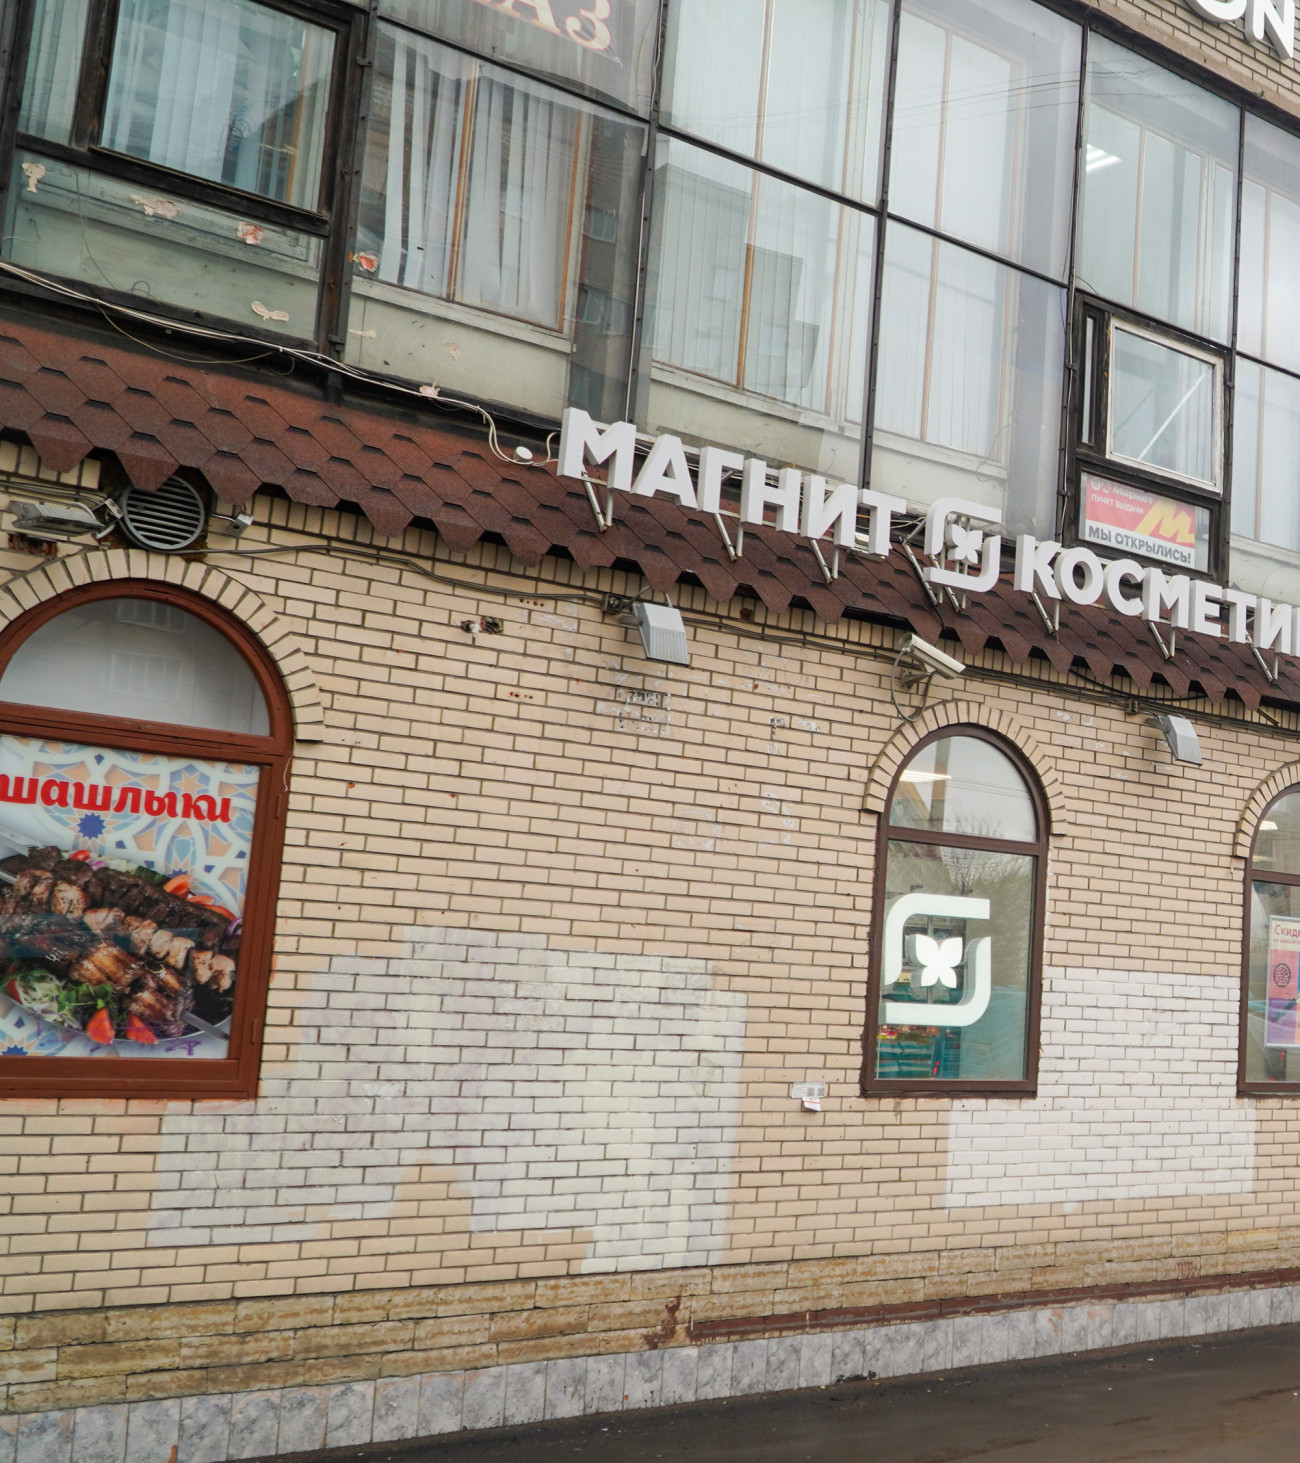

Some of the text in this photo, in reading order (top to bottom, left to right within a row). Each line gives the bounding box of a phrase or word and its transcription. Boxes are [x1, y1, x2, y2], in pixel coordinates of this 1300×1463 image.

[557, 407, 906, 560] МАГНИТ
[1091, 494, 1144, 515] ПУНКТ ВЫДАЧИ
[1088, 525, 1191, 564] МЫ ОТКРЫЛИСЬ!
[0, 773, 232, 823] шашлыки
